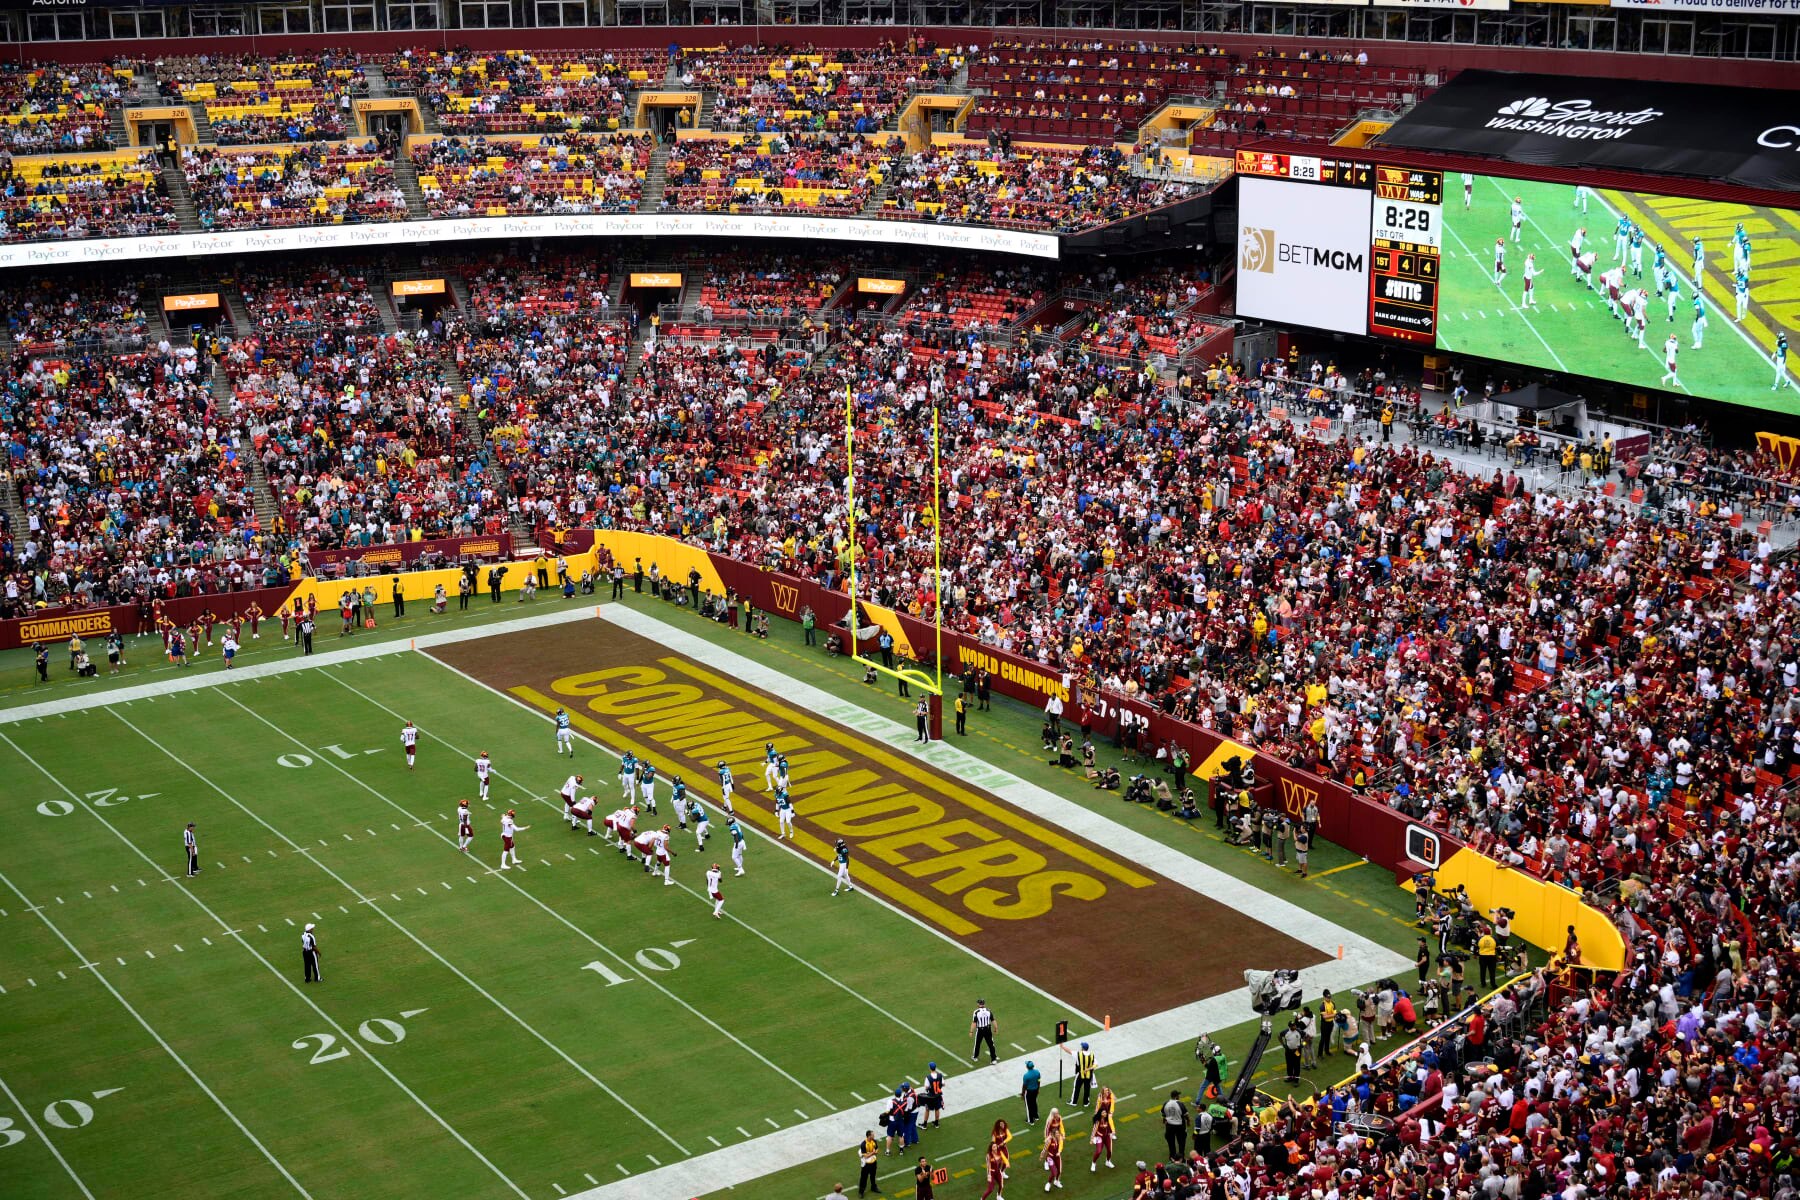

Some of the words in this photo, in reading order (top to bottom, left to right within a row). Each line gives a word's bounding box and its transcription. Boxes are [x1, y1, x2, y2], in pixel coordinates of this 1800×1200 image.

[646, 95, 658, 103] 327
[359, 102, 372, 110] 326
[130, 111, 144, 120] 325
[1544, 99, 1664, 125] Sports
[1485, 117, 1632, 140] WASHINGTON
[1293, 166, 1315, 178] 8:29
[1322, 169, 1335, 179] 1ST
[1344, 170, 1352, 181] 4
[1360, 172, 1367, 183] 4
[1410, 173, 1423, 182] JAX
[1433, 177, 1438, 185] 3
[1410, 190, 1424, 199] WAS
[1386, 206, 1430, 232] 8:29
[1376, 229, 1389, 237] 1ST
[28, 250, 70, 261] Paycor
[84, 246, 125, 257] Paycor
[138, 243, 181, 253] Paycor
[192, 240, 234, 250] Paycor
[246, 236, 287, 248] Paycor
[298, 233, 339, 243] Paycor
[350, 230, 391, 241] Paycor
[402, 228, 442, 238] Paycor
[453, 225, 493, 235] Paycor
[504, 223, 544, 233] Paycor
[555, 222, 594, 232] Paycor
[605, 221, 644, 231] Paycor
[656, 221, 694, 231] Paycor
[705, 221, 744, 232] Paycor
[754, 222, 792, 233] Paycor
[802, 224, 839, 234] Paycor
[848, 225, 884, 237] Paycor
[894, 228, 928, 239] Paycor
[938, 231, 971, 243] Paycor
[981, 235, 1013, 248] Paycor
[1020, 239, 1050, 251] Paycor
[1279, 243, 1363, 273] BETMGM
[1376, 256, 1389, 267] 1ST
[1402, 259, 1410, 270] 4
[1423, 262, 1431, 274] 4
[640, 276, 671, 285] Paycor
[867, 281, 896, 291] Paycor
[403, 283, 434, 293] Paycor
[1385, 279, 1422, 302] #HTTC
[175, 297, 208, 308] Paycor
[1374, 311, 1389, 319] BANK
[1397, 315, 1422, 325] AMERICA
[20, 615, 112, 639] COMMANDERS
[958, 644, 999, 675] WORLD
[1001, 661, 1070, 703] CHAMPIONS
[560, 717, 569, 726] 32
[822, 705, 893, 732] END
[551, 665, 1107, 922] COMMANDERS
[1424, 837, 1433, 861] 8
[580, 947, 680, 987] 10
[291, 1018, 406, 1065] 20
[935, 1169, 947, 1183] 10
